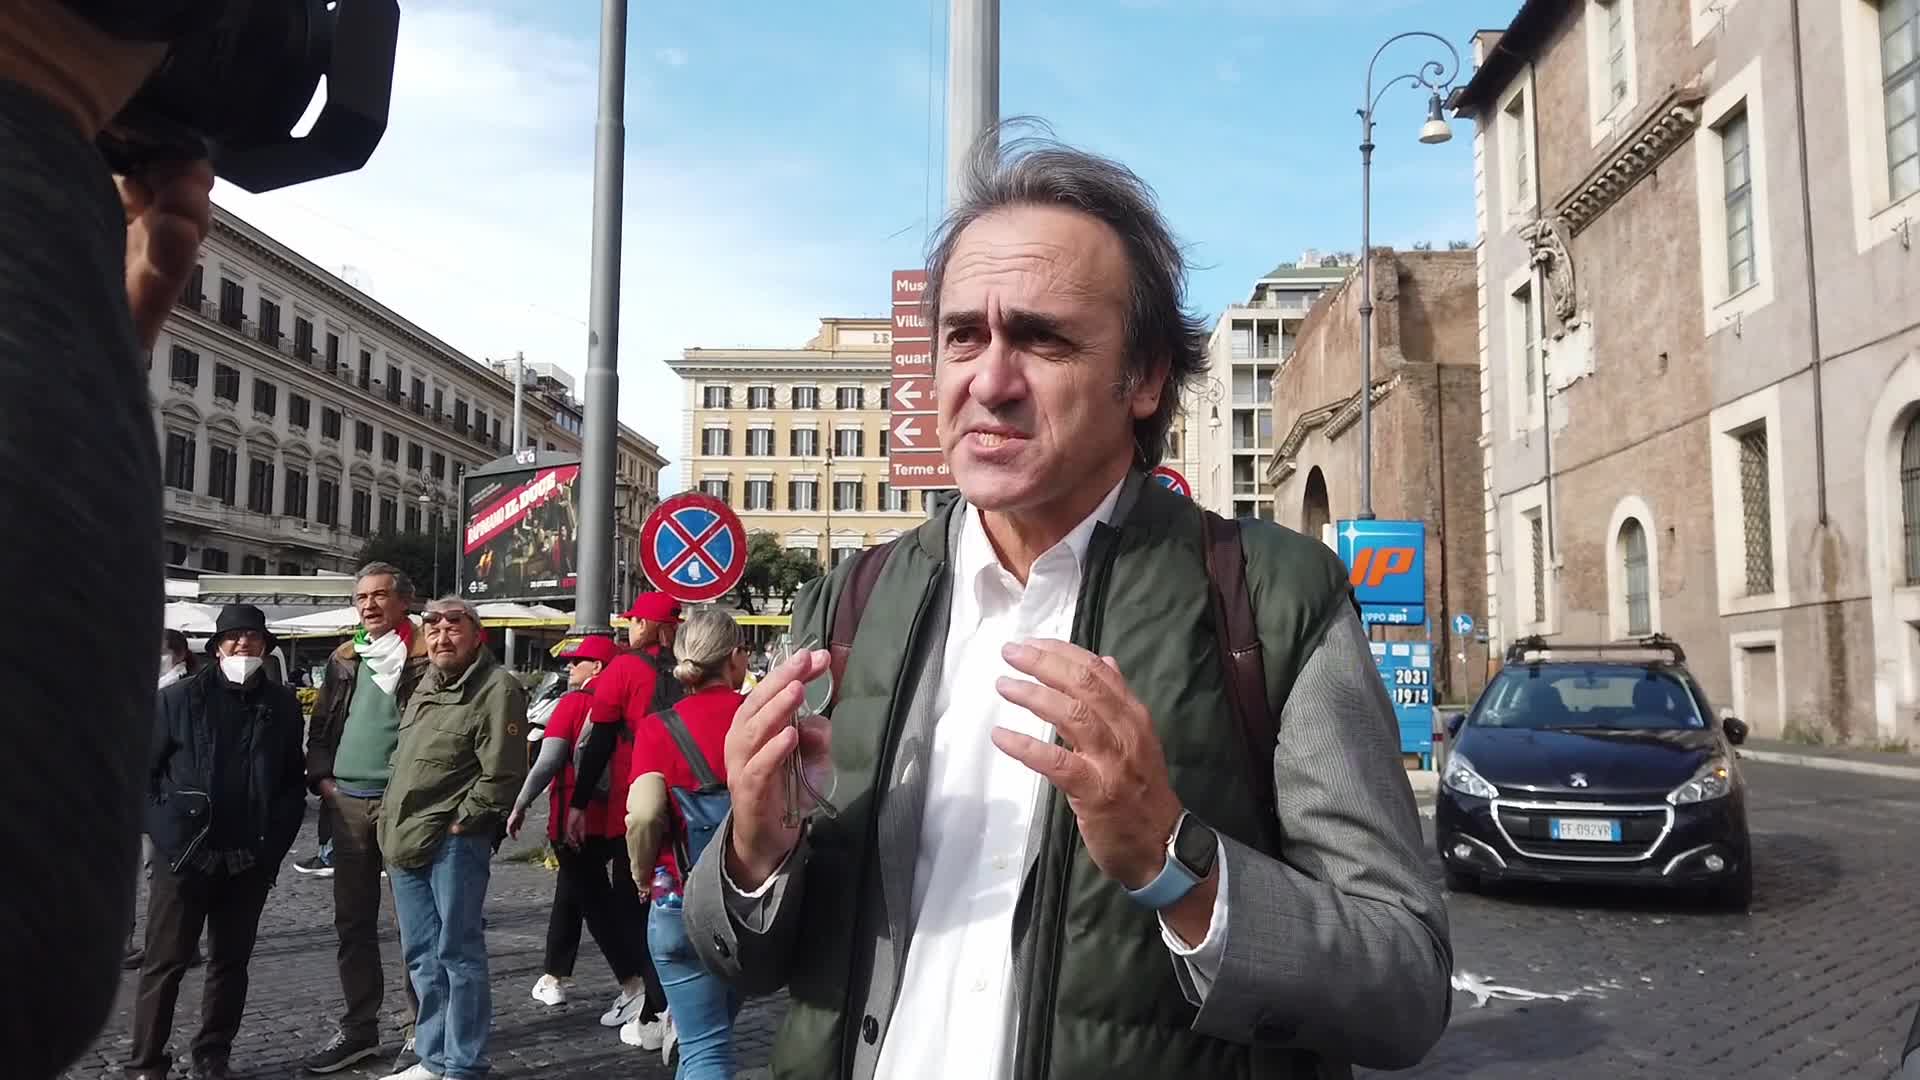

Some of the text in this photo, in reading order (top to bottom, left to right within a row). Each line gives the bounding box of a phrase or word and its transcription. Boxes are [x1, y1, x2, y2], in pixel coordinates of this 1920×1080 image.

[893, 463, 950, 476] Terme di
[1349, 547, 1416, 588] IP
[1388, 607, 1408, 624] api
[1396, 669, 1428, 685] 2031
